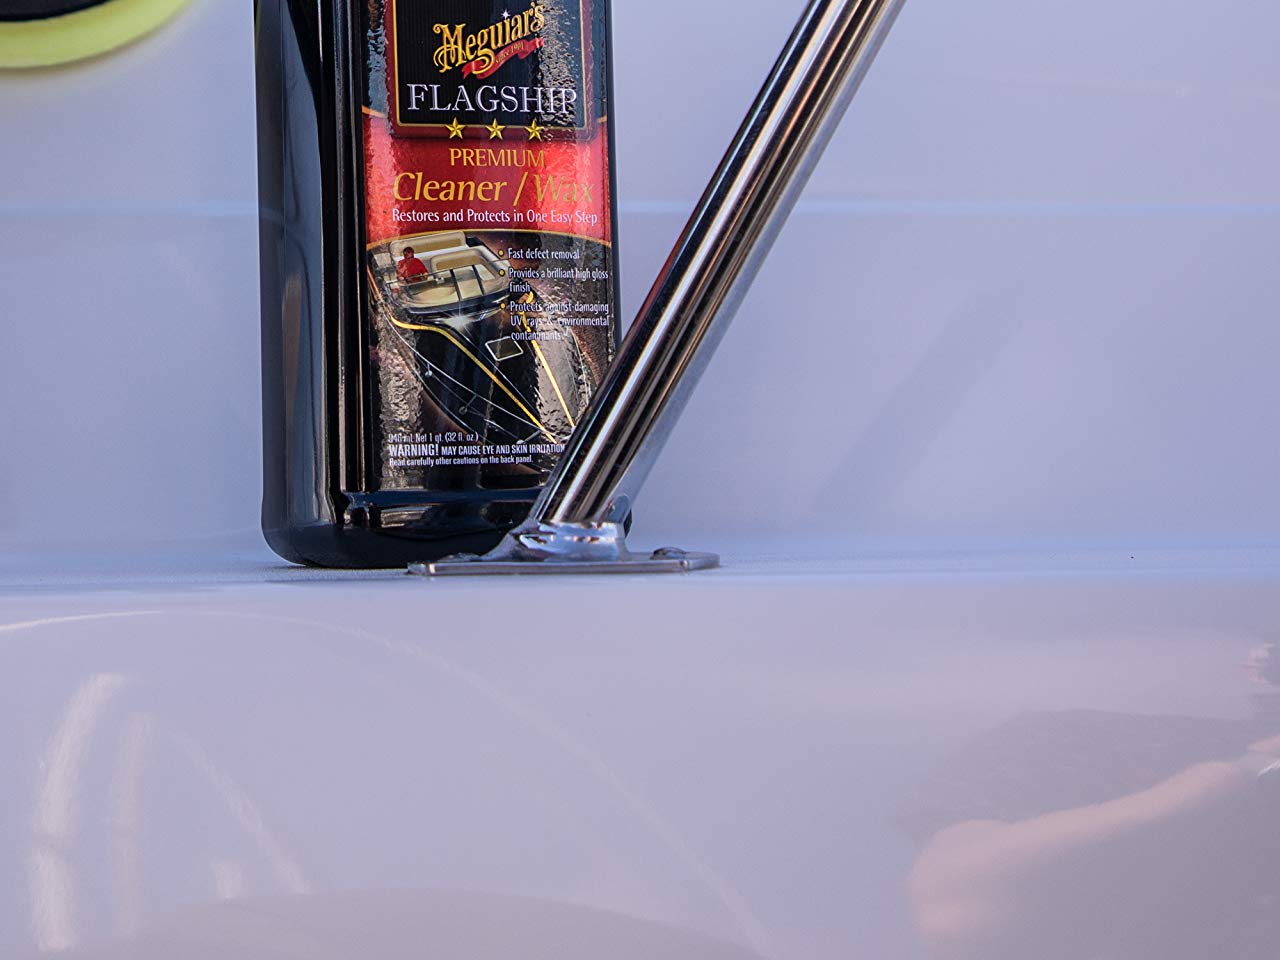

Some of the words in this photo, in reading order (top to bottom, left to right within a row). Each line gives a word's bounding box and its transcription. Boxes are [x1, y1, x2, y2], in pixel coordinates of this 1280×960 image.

[432, 1, 545, 75] Meguiar's
[406, 83, 577, 114] FLAGSHIP
[449, 148, 545, 168] PREMIUM
[393, 172, 508, 202] Cleaner
[533, 173, 595, 203] Wax
[392, 208, 439, 222] Restores
[443, 209, 463, 222] and
[467, 209, 510, 223] Protects
[513, 209, 524, 223] in
[527, 209, 547, 223] One
[551, 210, 573, 226] Easy
[575, 211, 598, 227] Step
[508, 247, 524, 259] Fast
[525, 247, 550, 259] defect
[551, 248, 580, 259] removal
[509, 268, 539, 279] Provides
[546, 267, 574, 279] brilliant
[575, 268, 591, 281] high
[592, 268, 609, 281] gloss
[509, 282, 531, 292] finish
[510, 301, 542, 312] Protects
[546, 302, 572, 314] against
[574, 301, 609, 315] damaging
[510, 315, 523, 326] UV
[527, 317, 542, 328] rays
[557, 315, 610, 326] environmental
[415, 432, 427, 443] Net
[445, 431, 457, 443] (32
[388, 443, 439, 457] WARNING!
[441, 446, 457, 455] MAY
[458, 445, 481, 455] CAUSE
[482, 445, 494, 455] EYE
[495, 444, 510, 454] AND
[511, 444, 528, 454] SKIN
[389, 457, 406, 467] Read
[406, 457, 434, 467] carefully
[435, 457, 452, 465] other
[453, 457, 479, 465] cautions
[489, 455, 499, 464] the
[500, 455, 514, 464] back
[515, 454, 534, 465] panel.
